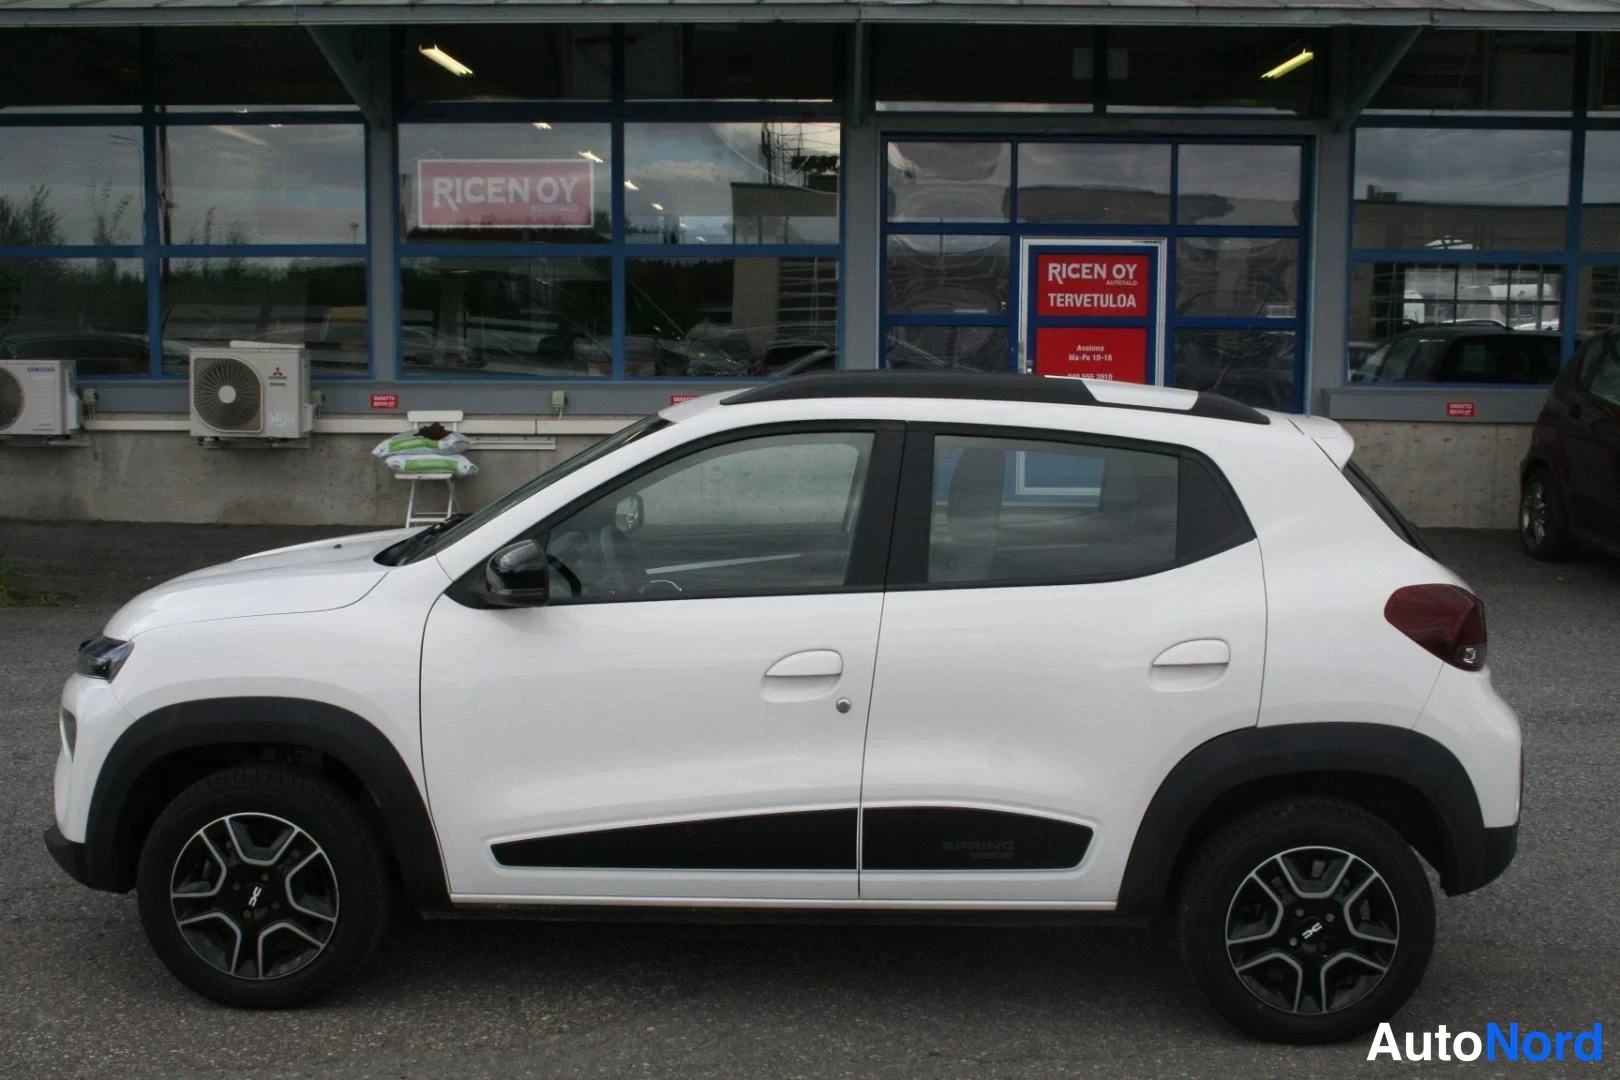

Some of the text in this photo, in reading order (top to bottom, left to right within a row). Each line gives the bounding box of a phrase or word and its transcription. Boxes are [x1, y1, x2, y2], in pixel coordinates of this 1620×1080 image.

[432, 175, 579, 212] RICEN OY
[1047, 262, 1138, 285] RICEN OY
[1105, 279, 1138, 287] AUTOTALO
[1047, 293, 1137, 309] TERVETULOA
[1076, 344, 1105, 352] Avoinna
[1068, 353, 1113, 362] Ma-Pe 10-18
[942, 840, 1014, 852] SPRING
